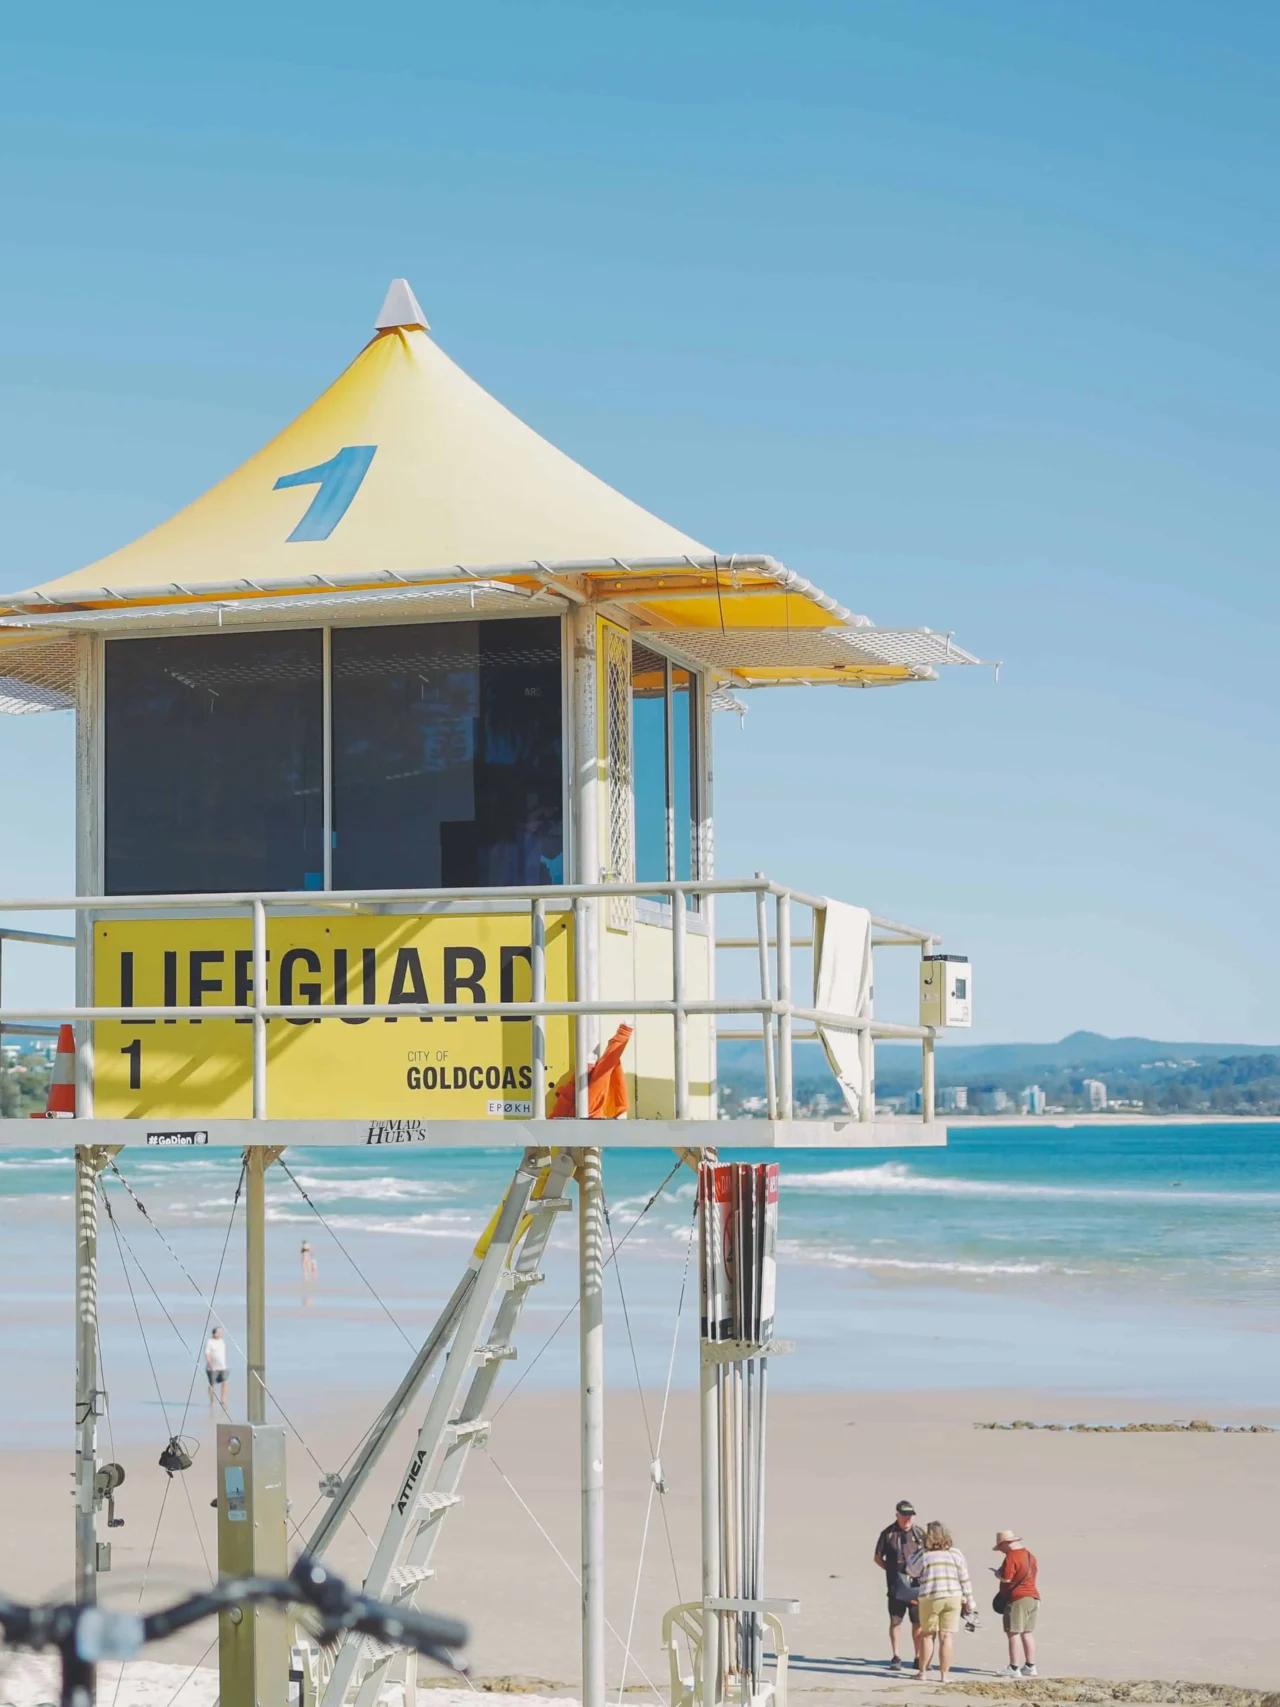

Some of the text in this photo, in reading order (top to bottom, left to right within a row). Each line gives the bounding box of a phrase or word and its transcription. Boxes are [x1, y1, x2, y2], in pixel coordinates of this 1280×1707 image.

[272, 445, 378, 543] 1
[121, 946, 546, 1025] LIFEGUARD
[120, 1040, 142, 1090] 1
[407, 1051, 449, 1062] CITY OF
[384, 1119, 421, 1131] MAD
[397, 1450, 427, 1516] ATTICA
